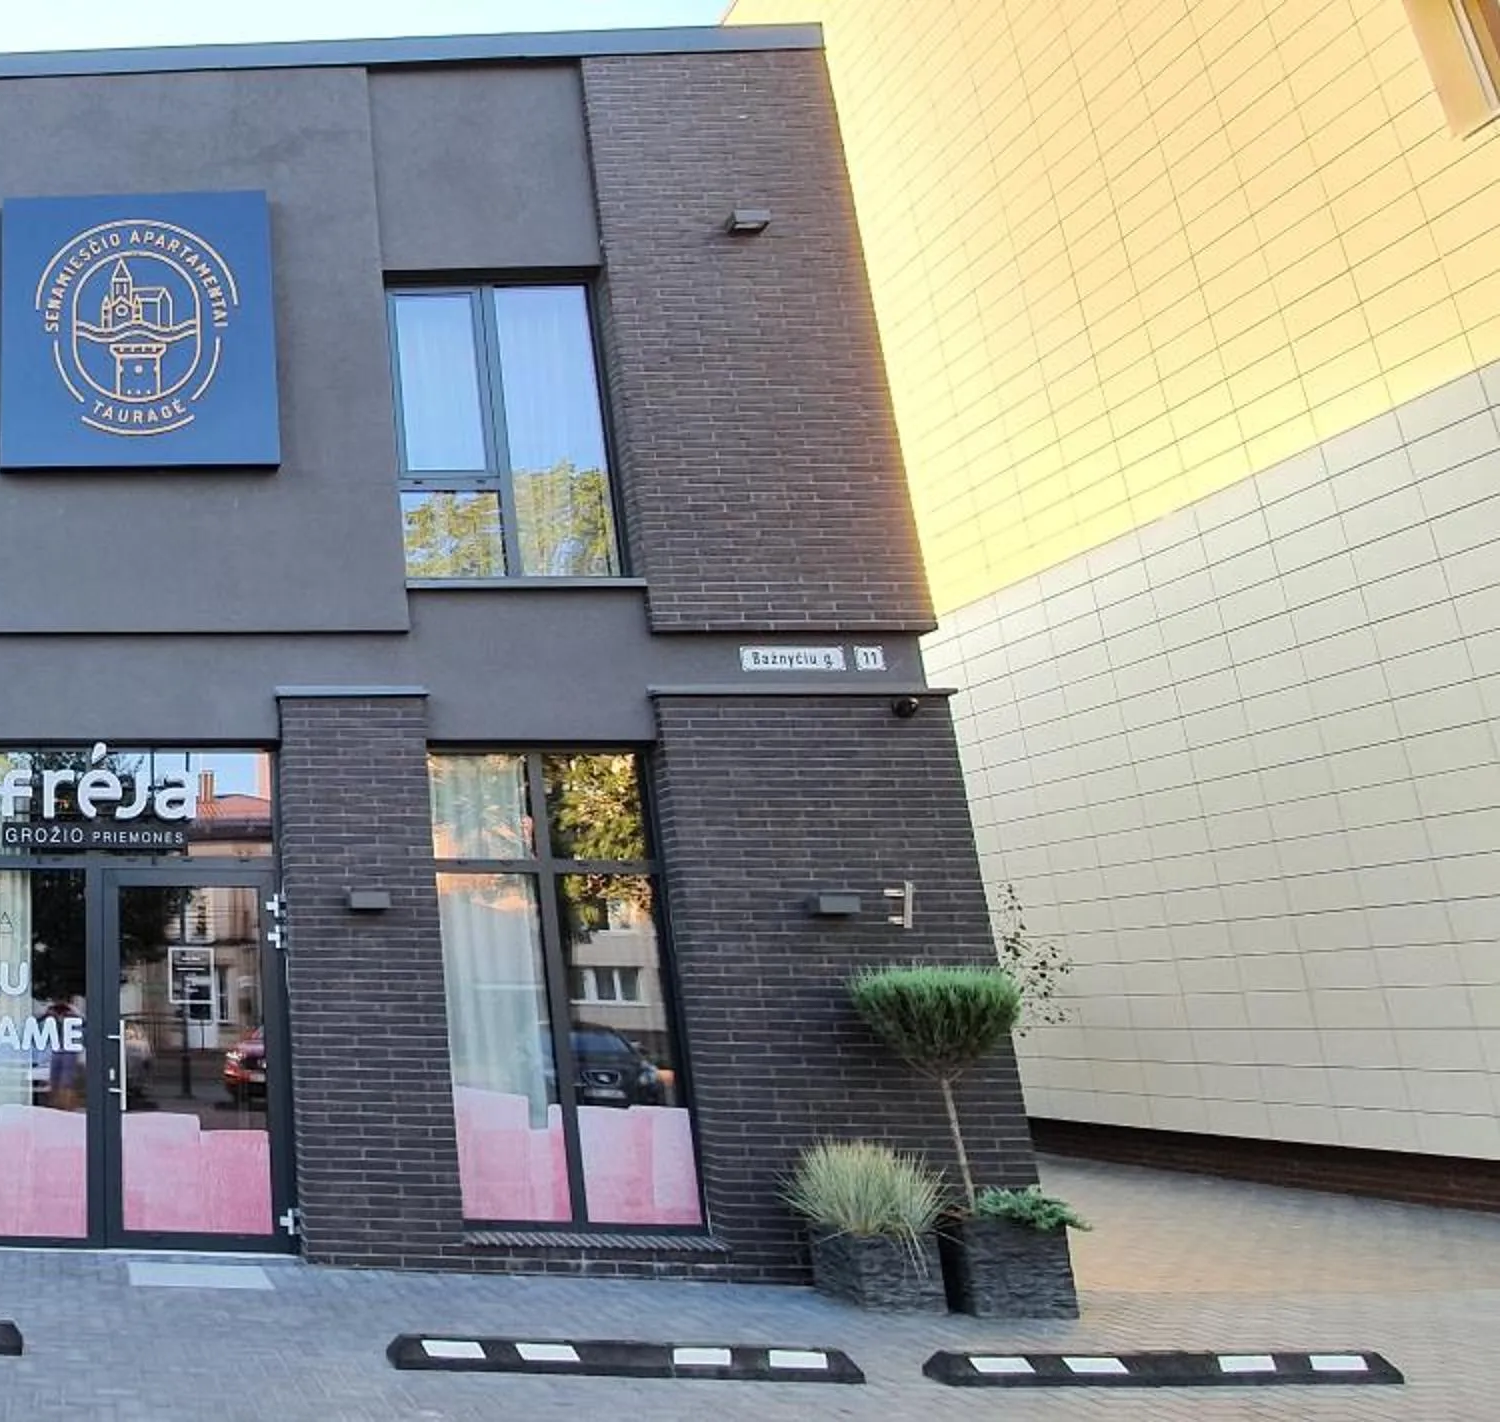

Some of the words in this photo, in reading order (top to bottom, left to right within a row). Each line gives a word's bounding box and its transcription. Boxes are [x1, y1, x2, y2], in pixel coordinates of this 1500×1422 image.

[45, 233, 121, 333] SENAMIESČIO
[130, 230, 229, 328] APARTAMENTAI
[93, 398, 187, 424] TAURAGĖ
[863, 652, 878, 665] 11
[5, 826, 83, 844] GROŽIO
